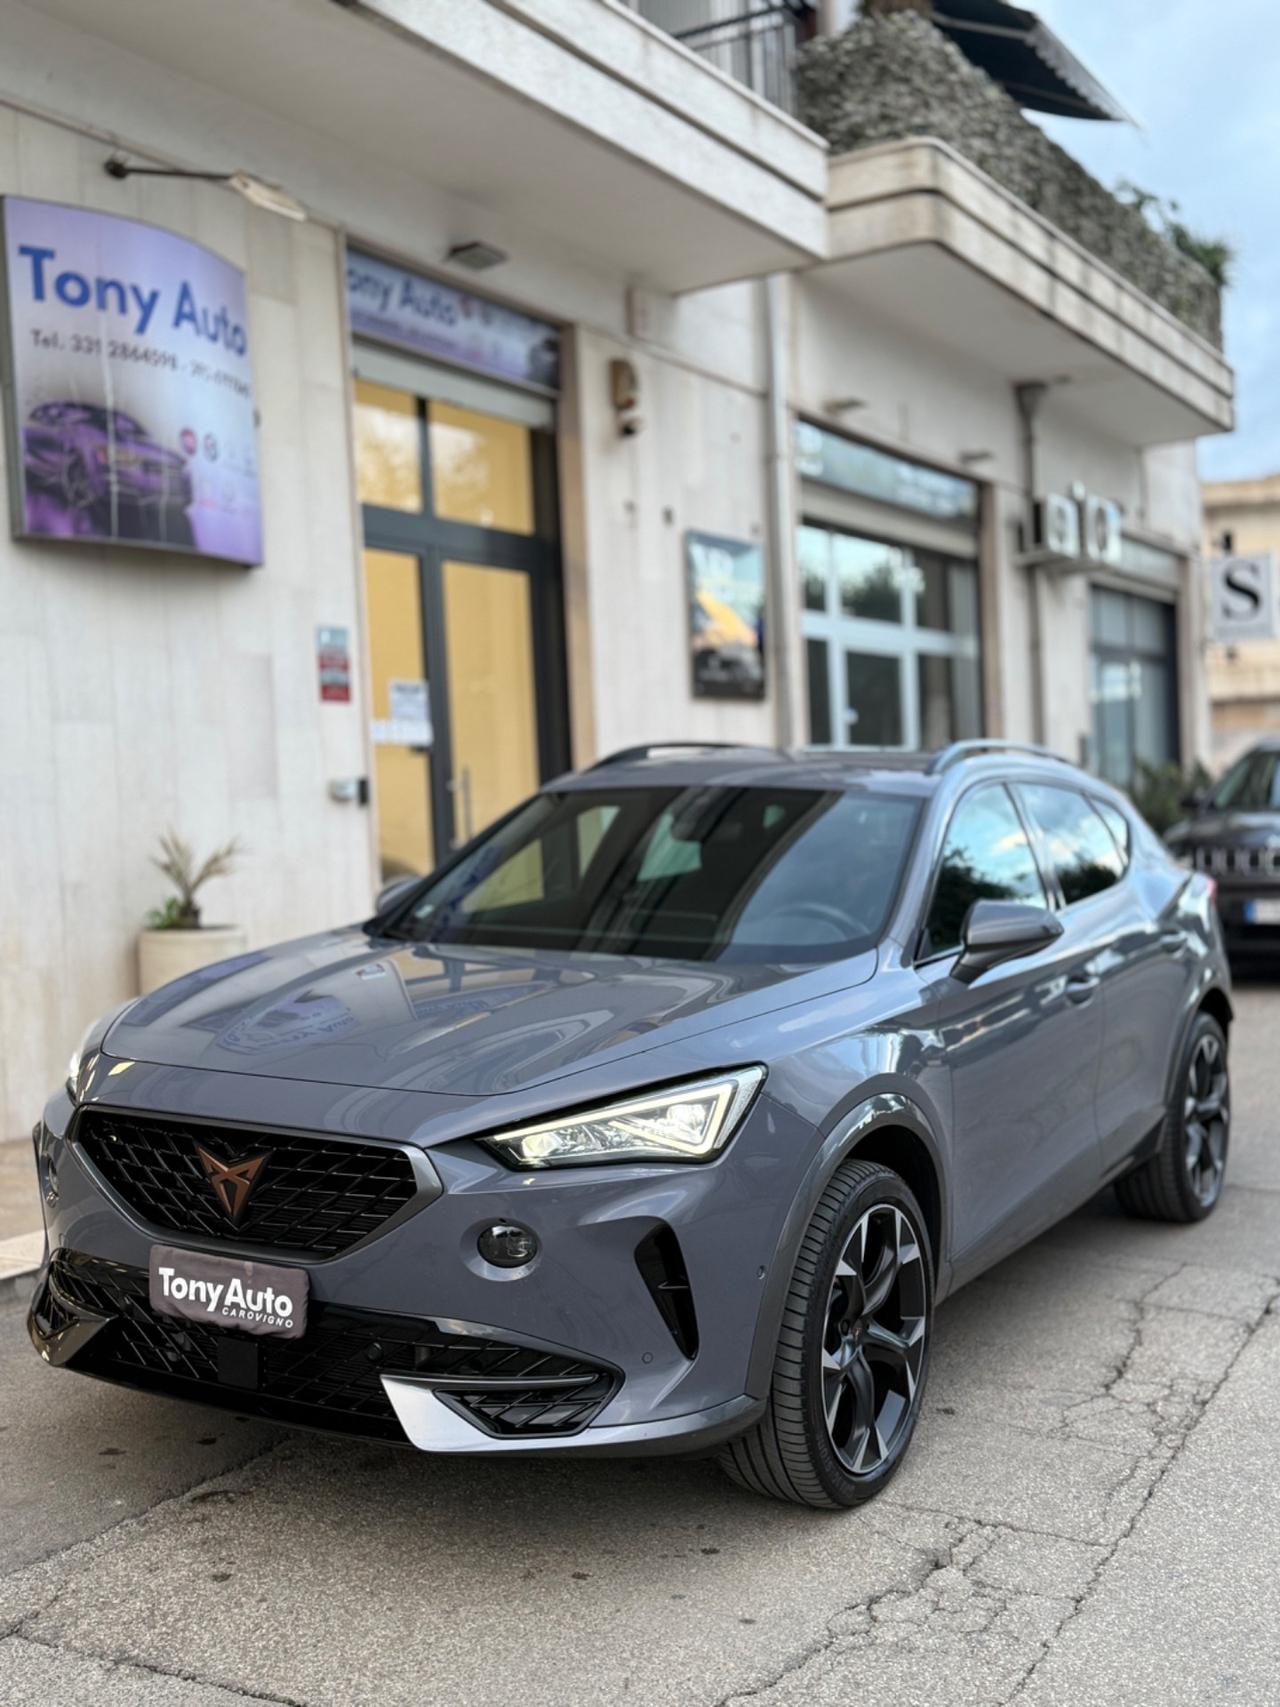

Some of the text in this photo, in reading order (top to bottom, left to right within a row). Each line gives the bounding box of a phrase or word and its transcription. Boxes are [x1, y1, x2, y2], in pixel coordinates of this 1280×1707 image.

[18, 245, 248, 357] Tony Auto
[222, 1307, 294, 1328] CAROVIGNO
